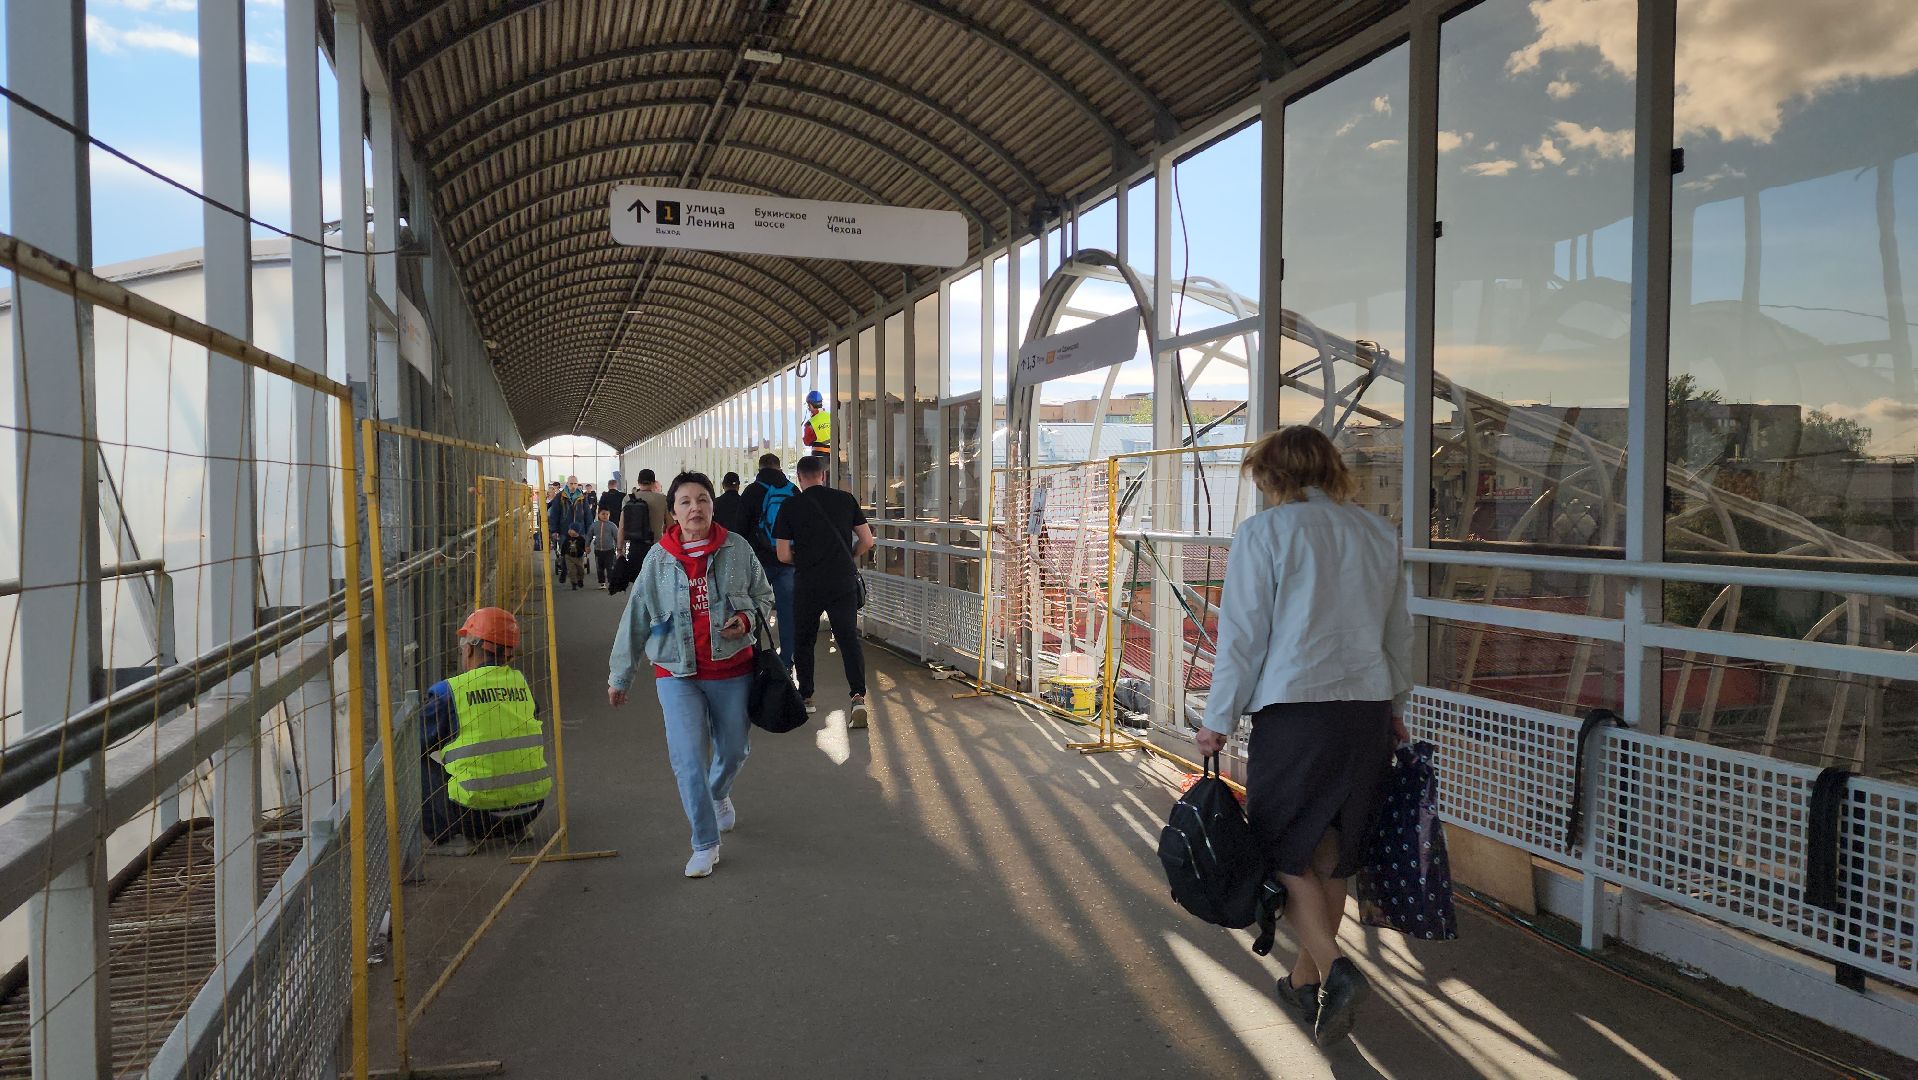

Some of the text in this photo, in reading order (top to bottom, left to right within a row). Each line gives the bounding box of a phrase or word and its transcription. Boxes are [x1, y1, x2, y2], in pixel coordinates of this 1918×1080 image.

[664, 206, 673, 220] 1
[686, 203, 725, 215] улица
[686, 215, 735, 230] Ленина
[754, 220, 785, 229] шоссе
[827, 214, 856, 224] улица
[827, 224, 862, 235] Чехова
[466, 687, 528, 706] ИМПЕРИАЛ
